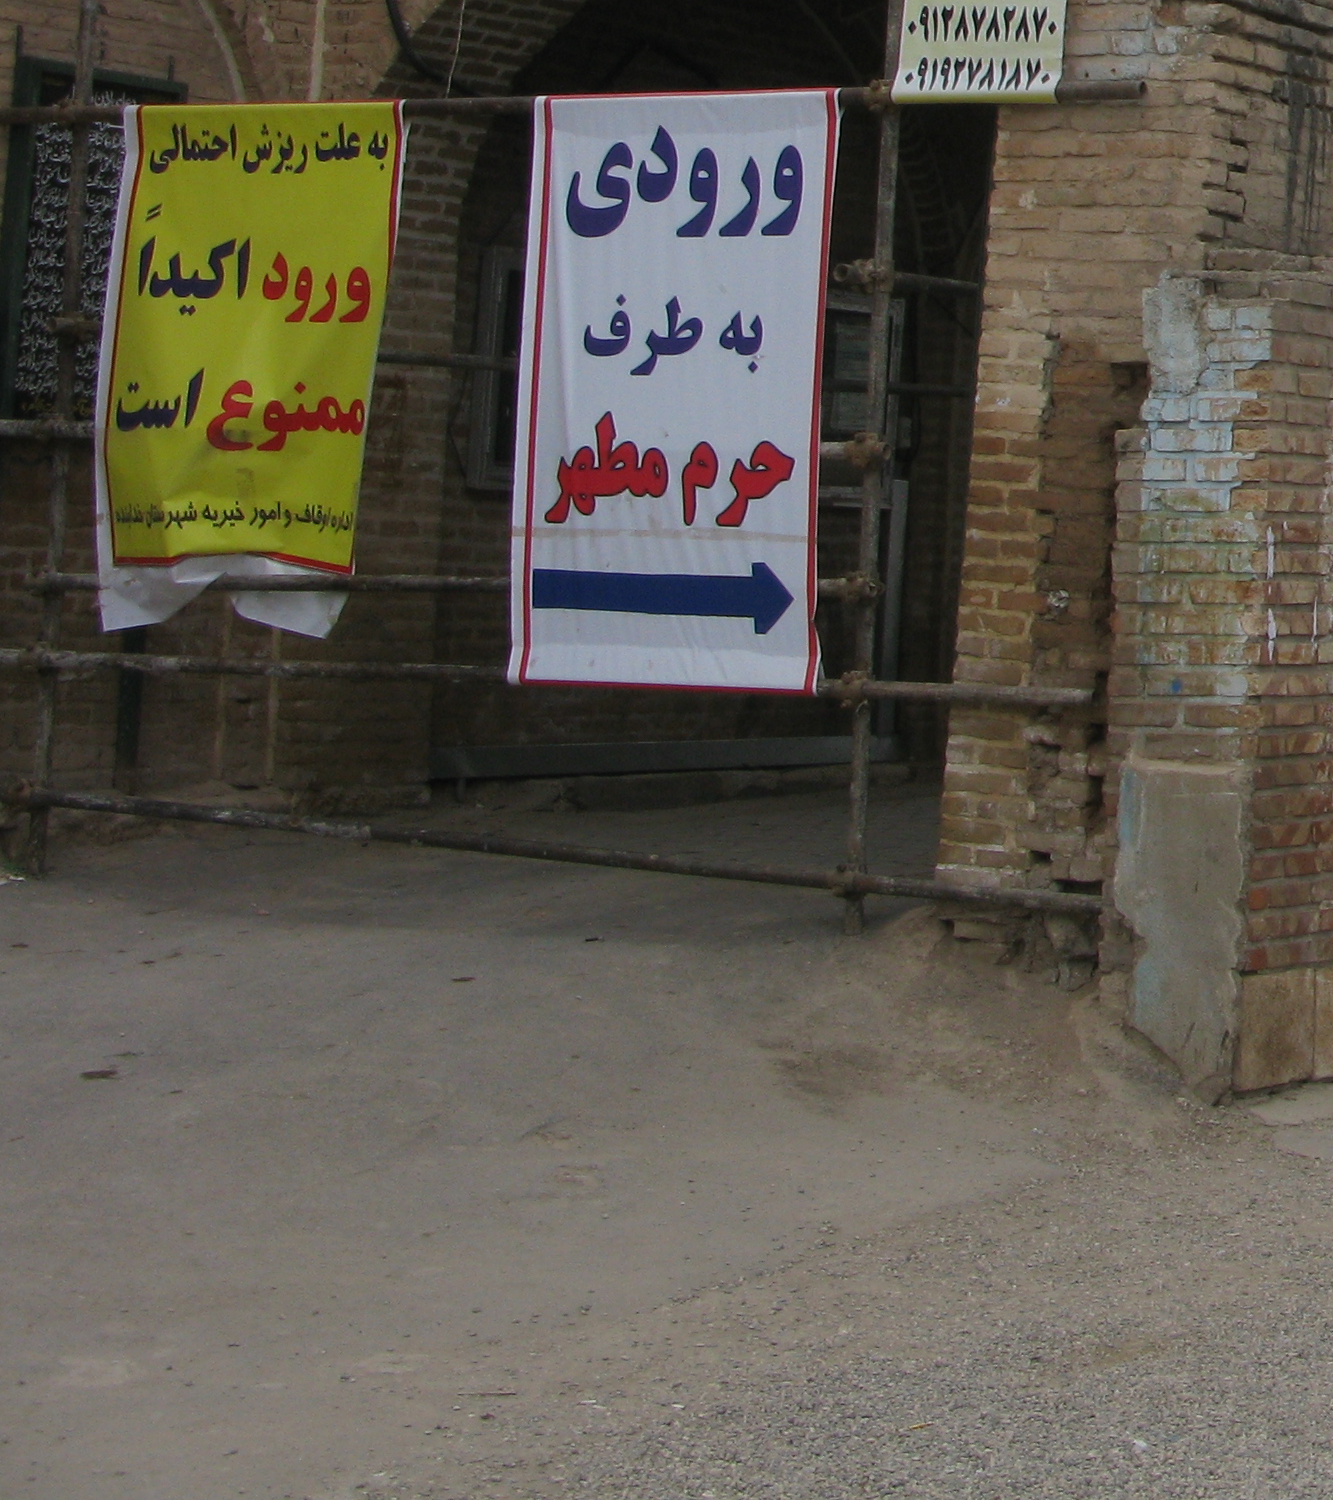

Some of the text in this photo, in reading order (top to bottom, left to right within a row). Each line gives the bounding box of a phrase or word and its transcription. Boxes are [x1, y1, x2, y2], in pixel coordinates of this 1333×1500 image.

[149, 122, 389, 174] به علت ریزش احتمالی
[566, 125, 803, 238] ورودی
[262, 251, 371, 323] ورود
[584, 294, 763, 376] به طرف
[115, 368, 365, 451] ممنوع است
[545, 411, 795, 527] حرم مطهر
[203, 501, 245, 528] خیریه
[249, 501, 281, 529] امور
